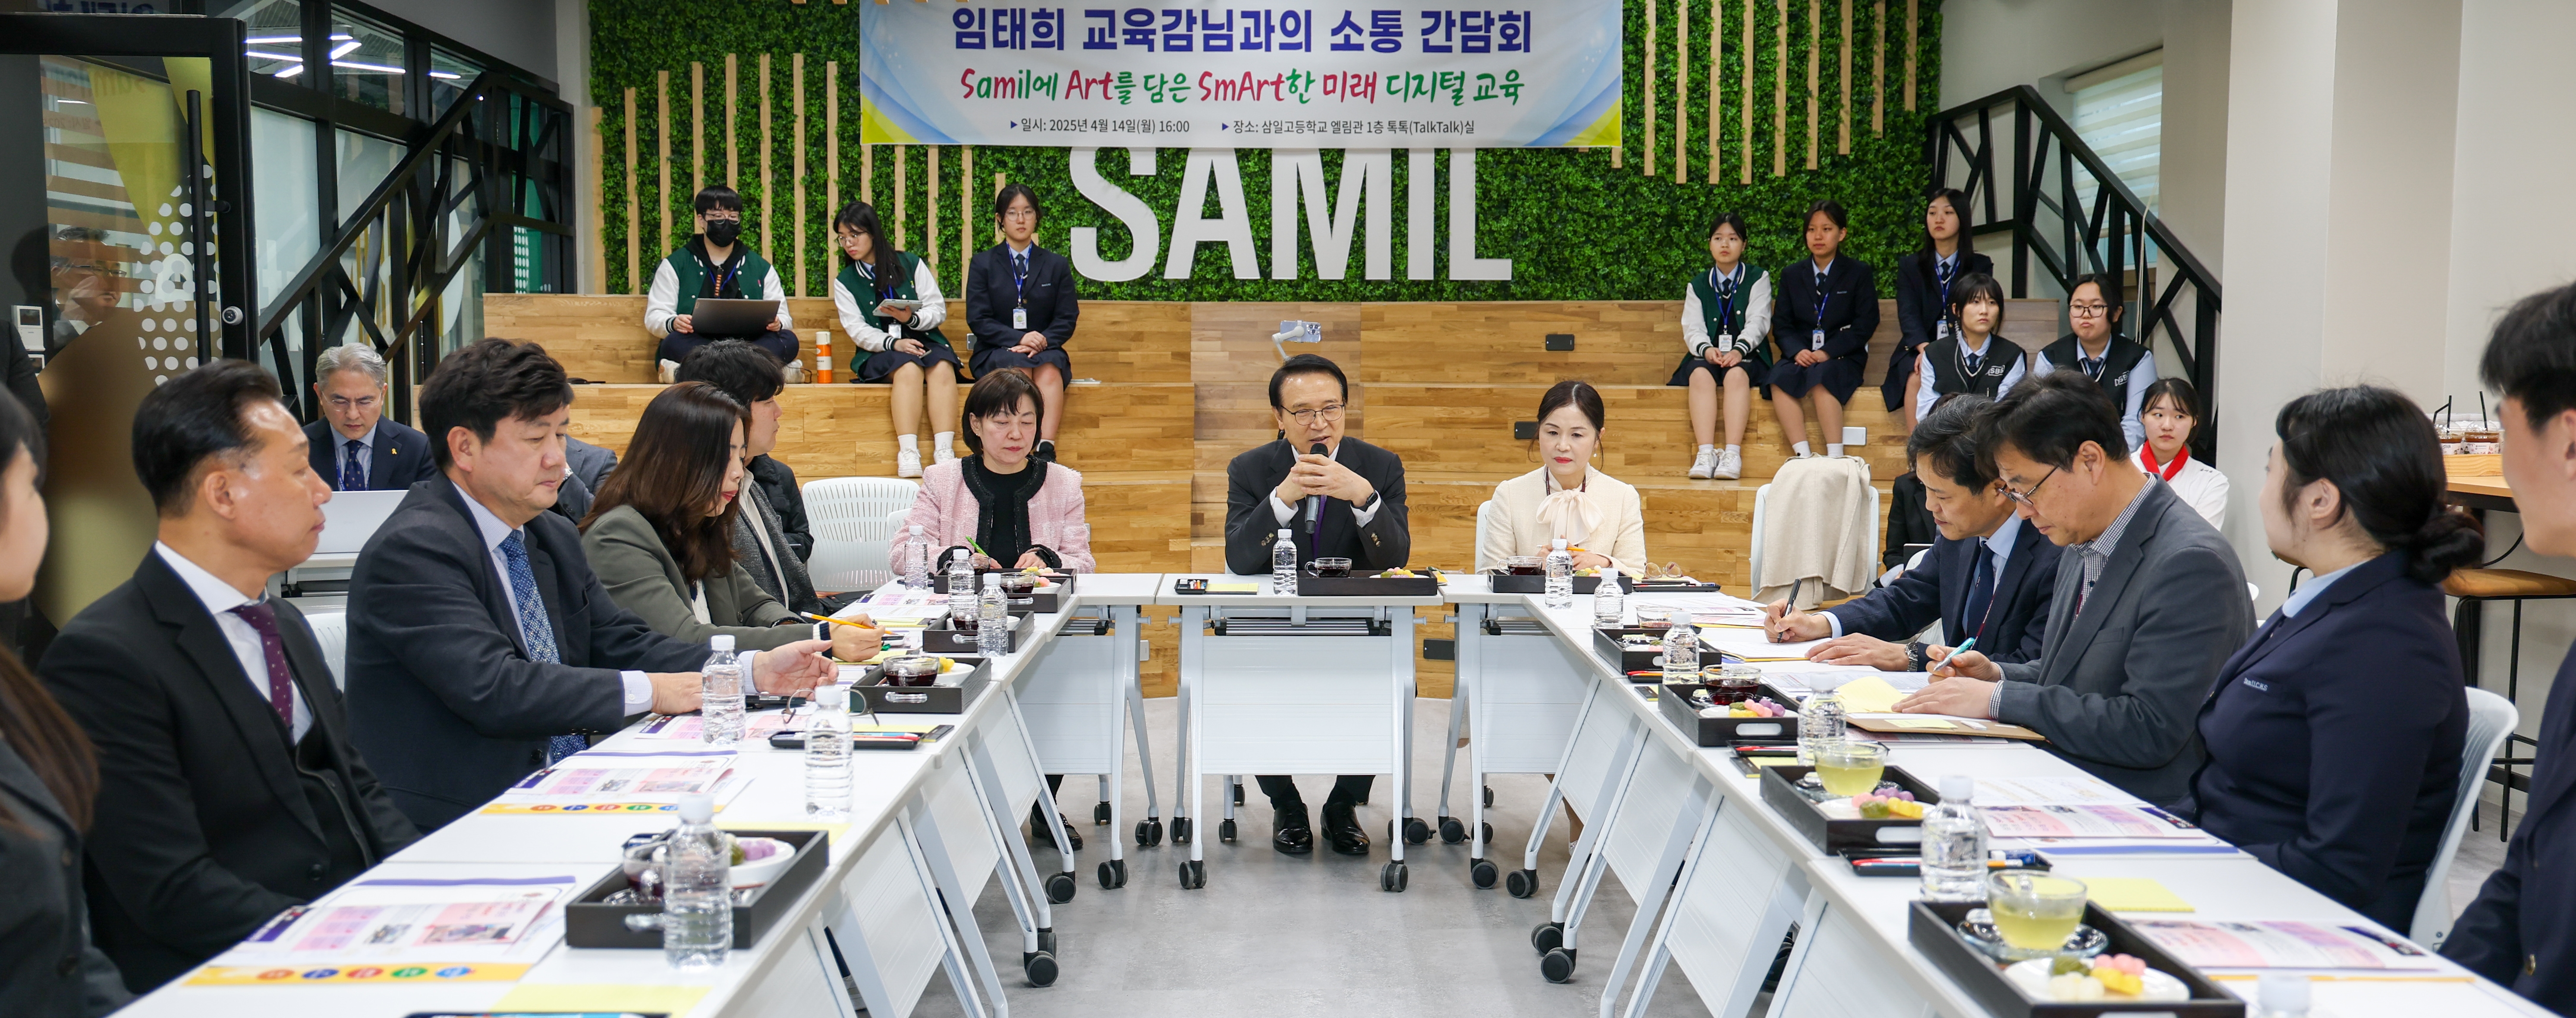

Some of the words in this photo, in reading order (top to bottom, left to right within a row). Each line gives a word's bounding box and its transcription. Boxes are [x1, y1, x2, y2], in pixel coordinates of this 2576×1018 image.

[952, 7, 1064, 51] 임태희
[1083, 8, 1312, 52] 교육감님과의
[1330, 10, 1403, 53] 소통
[1421, 10, 1531, 54] 간담회
[961, 68, 1058, 101] Samil에
[1065, 69, 1136, 105] Art를
[1143, 72, 1191, 103] 담은
[1198, 68, 1316, 104] SmArt한
[1323, 71, 1377, 104] 미래
[1386, 71, 1466, 106] 디지털
[1473, 69, 1525, 106] 교육
[1021, 117, 1046, 132] 일시:
[1049, 118, 1088, 132] 2025년
[1090, 119, 1108, 132] 4월
[1112, 119, 1155, 135] 14일(월)
[1159, 120, 1190, 132] 16:00
[1233, 120, 1259, 134] 장소:
[1262, 120, 1327, 134] 삼일고등학교
[1330, 120, 1363, 134] 엘림관
[1366, 120, 1384, 134] 1층
[1387, 120, 1475, 136] 톡톡(TalkTalk)실
[1069, 146, 1512, 282] SAMIL
